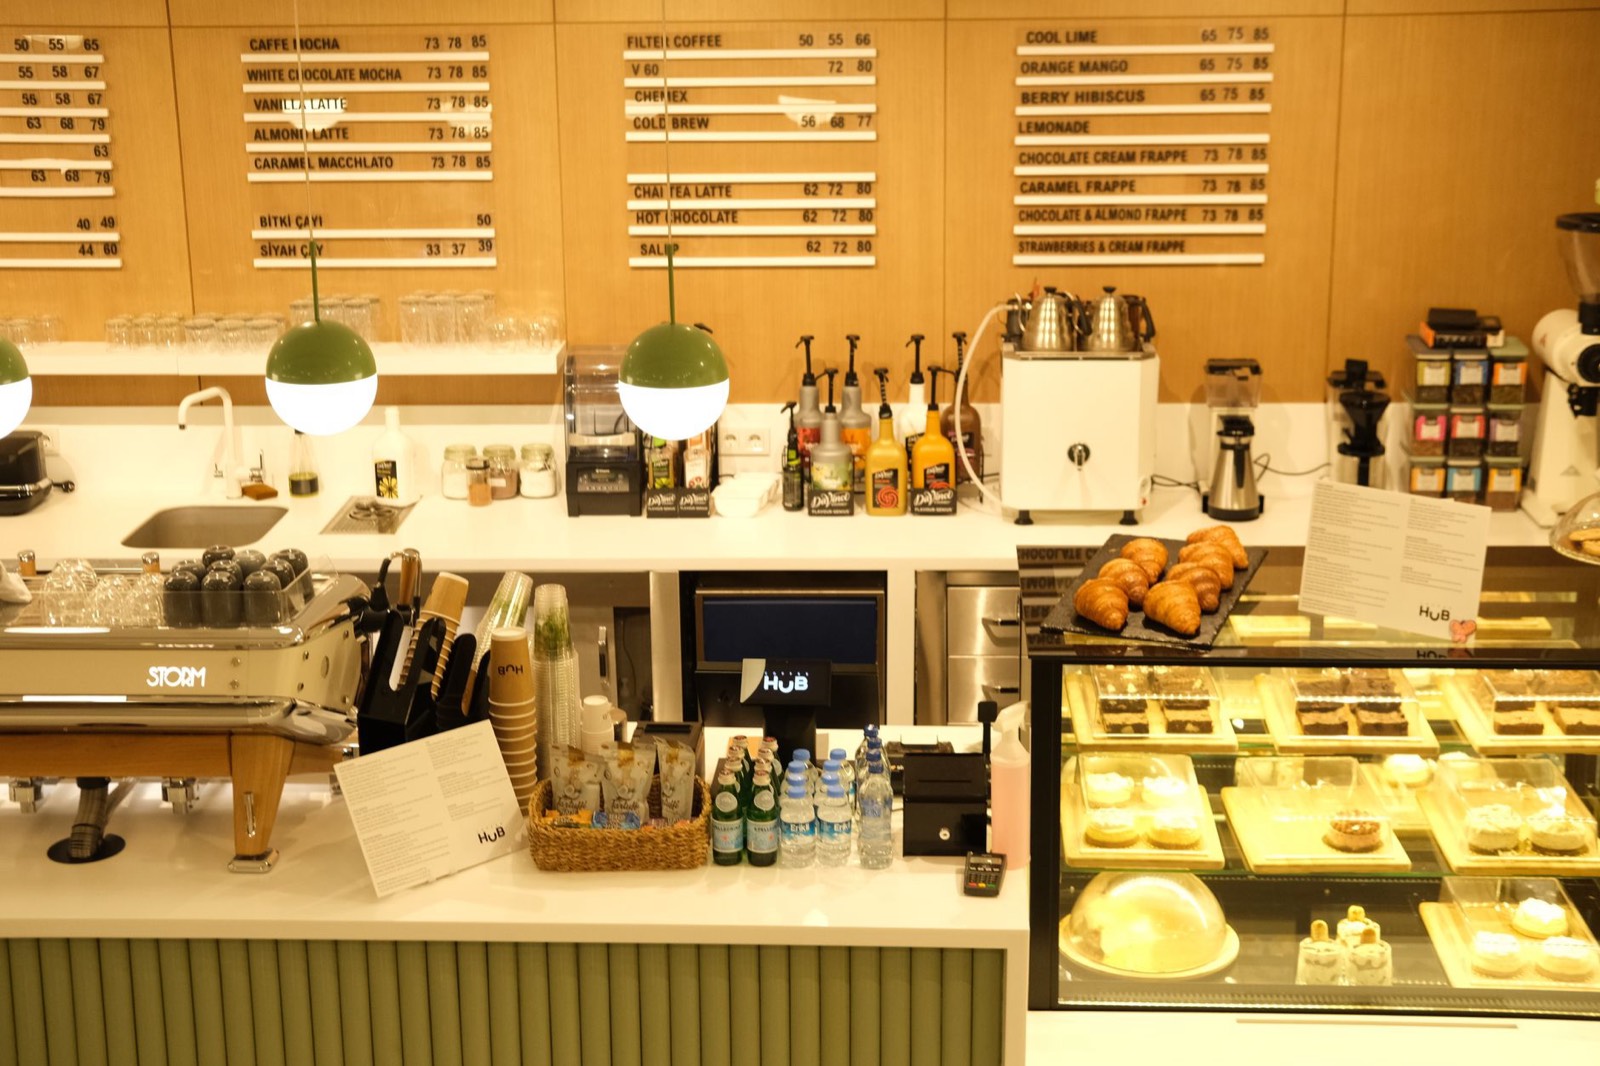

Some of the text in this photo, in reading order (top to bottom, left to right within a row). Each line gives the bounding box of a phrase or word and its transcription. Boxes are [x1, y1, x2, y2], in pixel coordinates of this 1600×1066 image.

[627, 33, 871, 48] FILTER COFFEE 50 55 66
[1026, 27, 1269, 43] COOL LIME 65 75 85
[14, 38, 99, 51] 50 55 65
[249, 35, 487, 51] CAFFE MOCHA 73 78 85
[18, 65, 99, 79] 55 58 67
[247, 65, 487, 81] WHITE CHOCOLATE MOCHA 73 78 85
[631, 60, 872, 76] V 60 72 80
[1020, 57, 1269, 74] ORANGE MANGO 65 75 85
[55, 92, 71, 105] 58
[87, 92, 102, 105] 67
[635, 90, 688, 103] CHEMEX
[1021, 87, 1265, 104] BERRY HIBISCUS 65 75 85
[254, 96, 489, 111] VANILLA LATTE 73 78 85
[26, 116, 105, 131] 63 68 79
[633, 115, 872, 129] COLD BREW 56 68 77
[1018, 121, 1090, 134] LEMONADE
[254, 125, 489, 141] ALMOND LATTE 73 78 85
[93, 144, 109, 157] 63
[1018, 147, 1267, 165] CHOCOLATE CREAM FRAPPE 73 78 85
[254, 156, 315, 170] CARAMEL
[431, 156, 445, 169] 73
[451, 155, 466, 168] 78
[476, 156, 491, 169] 85
[31, 169, 111, 184] 63 68 79
[634, 182, 872, 198] CHAI TEA LATTE 62 72 80
[1020, 178, 1265, 193] CARAMEL FRAPPE 73 78 85
[259, 213, 491, 230] BİTKİ ÇAYI 50
[636, 209, 873, 224] HOT CHOCOLATE 62 72 80
[1018, 208, 1263, 222] CHOCOLATE & ALMOND FRAPPE 73 78 85
[76, 216, 116, 231] 40 49
[78, 242, 118, 256] 44 60
[260, 239, 493, 258] SİYAH ÇY 33 37 39
[806, 240, 821, 253] 62
[833, 241, 847, 253] 72
[857, 240, 872, 253] 80
[1018, 241, 1095, 253] STRAWBERRIES
[1108, 241, 1143, 253] CREAM
[1146, 241, 1185, 253] FRAPPE
[1419, 605, 1450, 621] HUB
[146, 666, 206, 687] STORM
[497, 664, 524, 676] HUB
[763, 675, 808, 693] HUB
[477, 826, 506, 844] HUB
